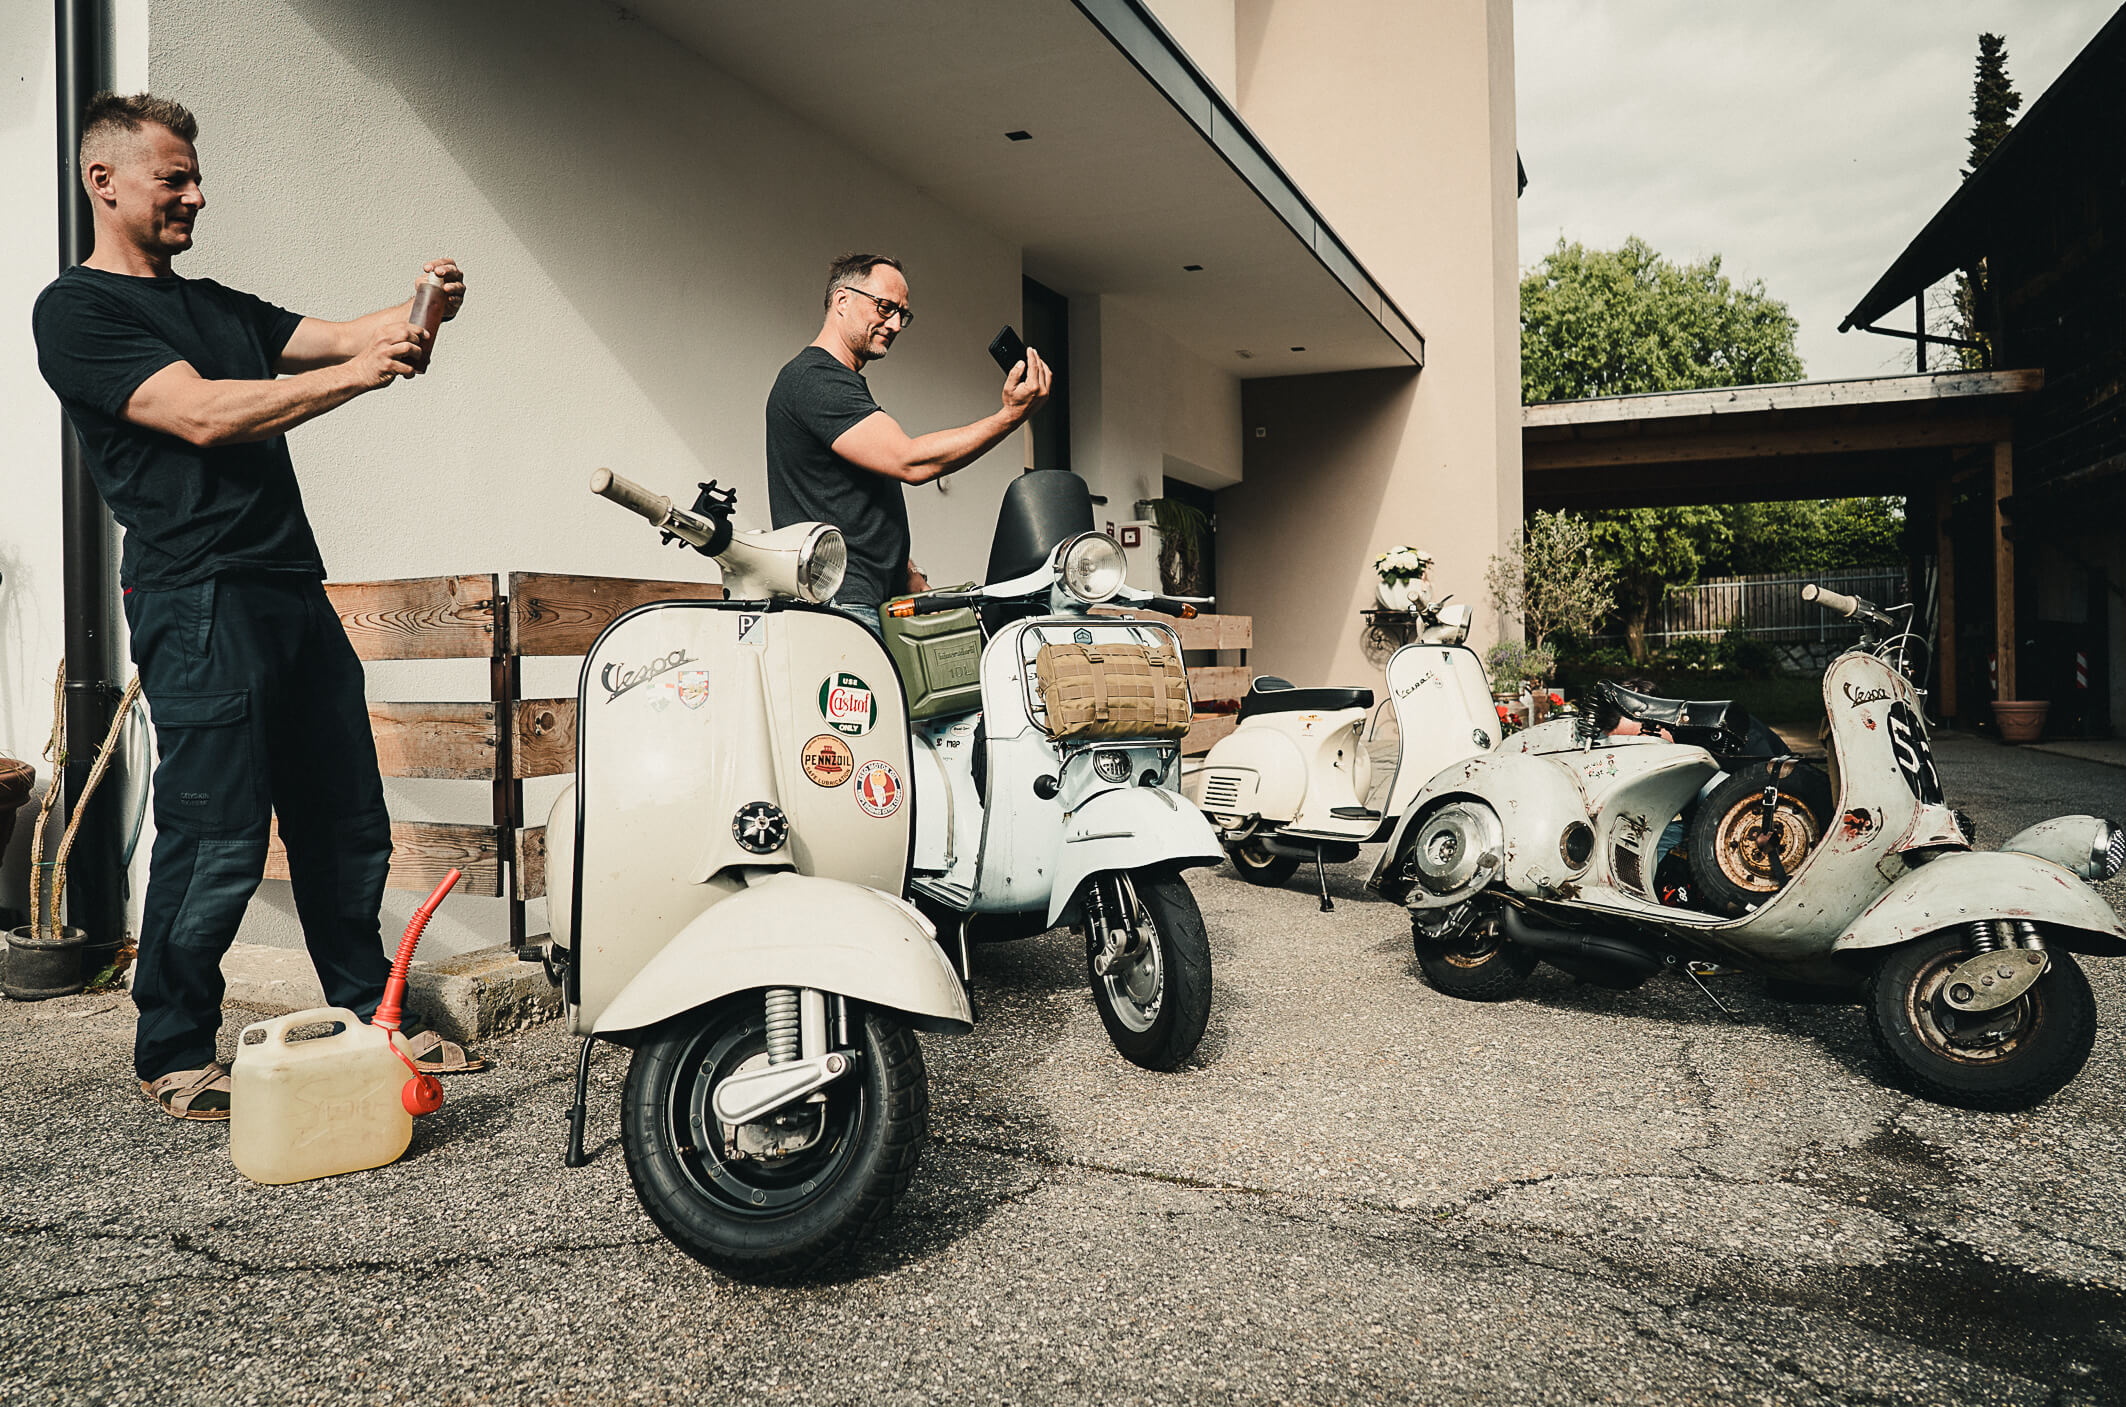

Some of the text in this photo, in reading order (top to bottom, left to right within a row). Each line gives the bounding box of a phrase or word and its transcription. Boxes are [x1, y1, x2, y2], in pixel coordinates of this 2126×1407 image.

[740, 616, 754, 634] P
[601, 649, 700, 705] Vespa
[842, 678, 858, 686] USE
[829, 688, 870, 717] Castrol
[1843, 681, 1892, 709] Vespa
[838, 724, 859, 732] ONLY
[805, 754, 852, 767] PENNZOIL
[806, 766, 851, 785] SAFE LUBRICATION
